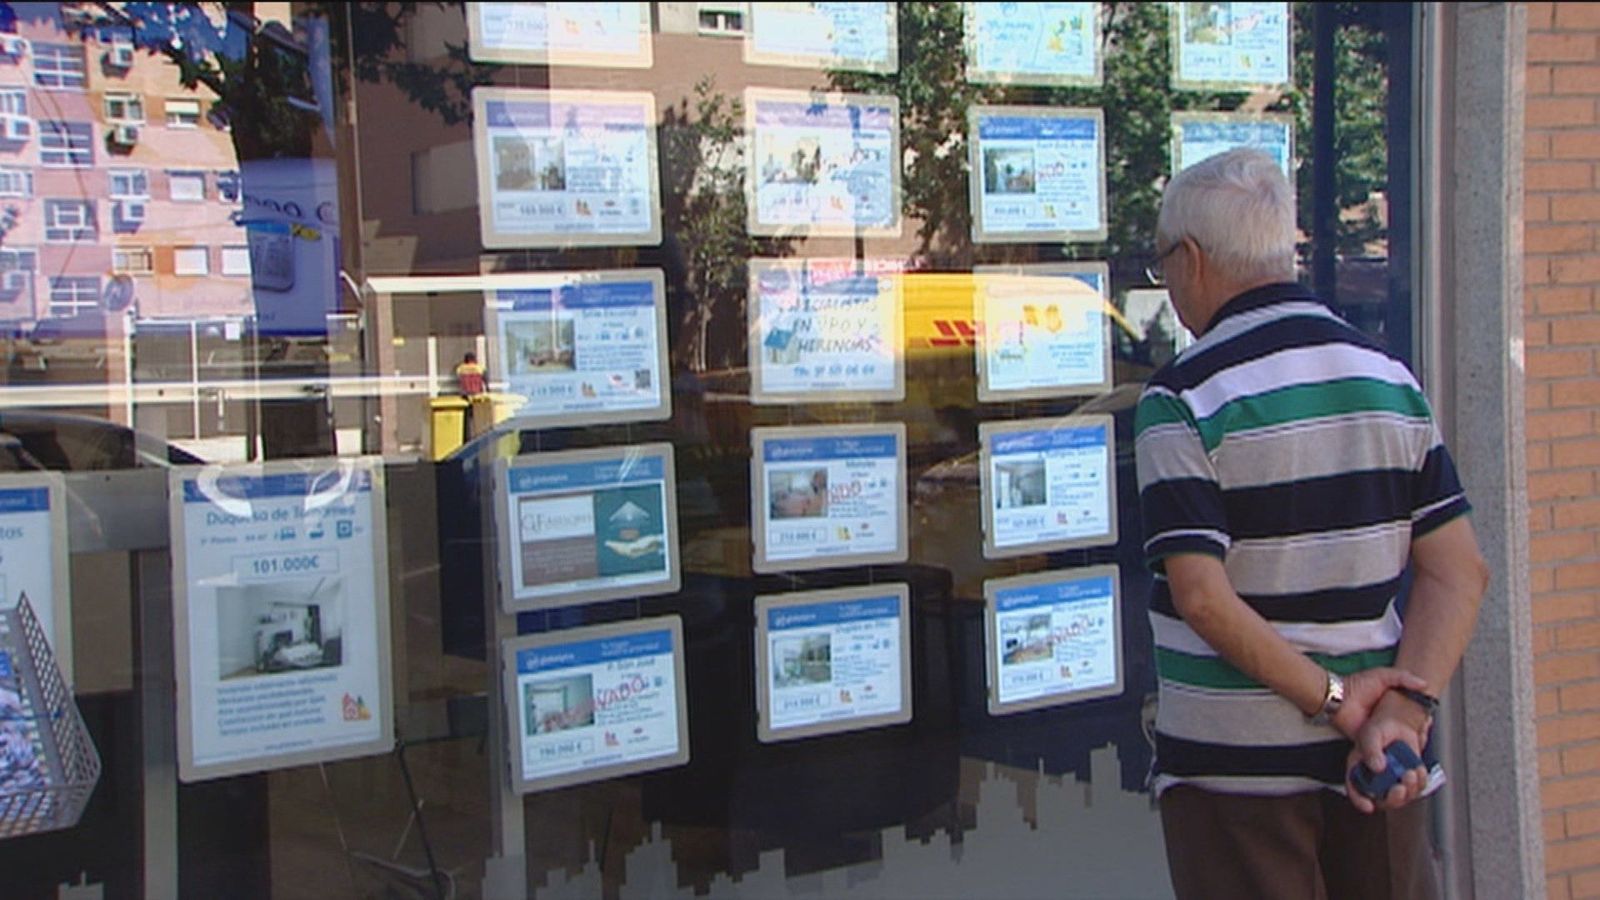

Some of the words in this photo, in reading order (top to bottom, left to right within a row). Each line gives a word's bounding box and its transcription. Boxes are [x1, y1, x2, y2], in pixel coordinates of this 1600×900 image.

[206, 510, 269, 526] Duqusa
[271, 507, 289, 521] de
[252, 554, 320, 574] 101.000€
